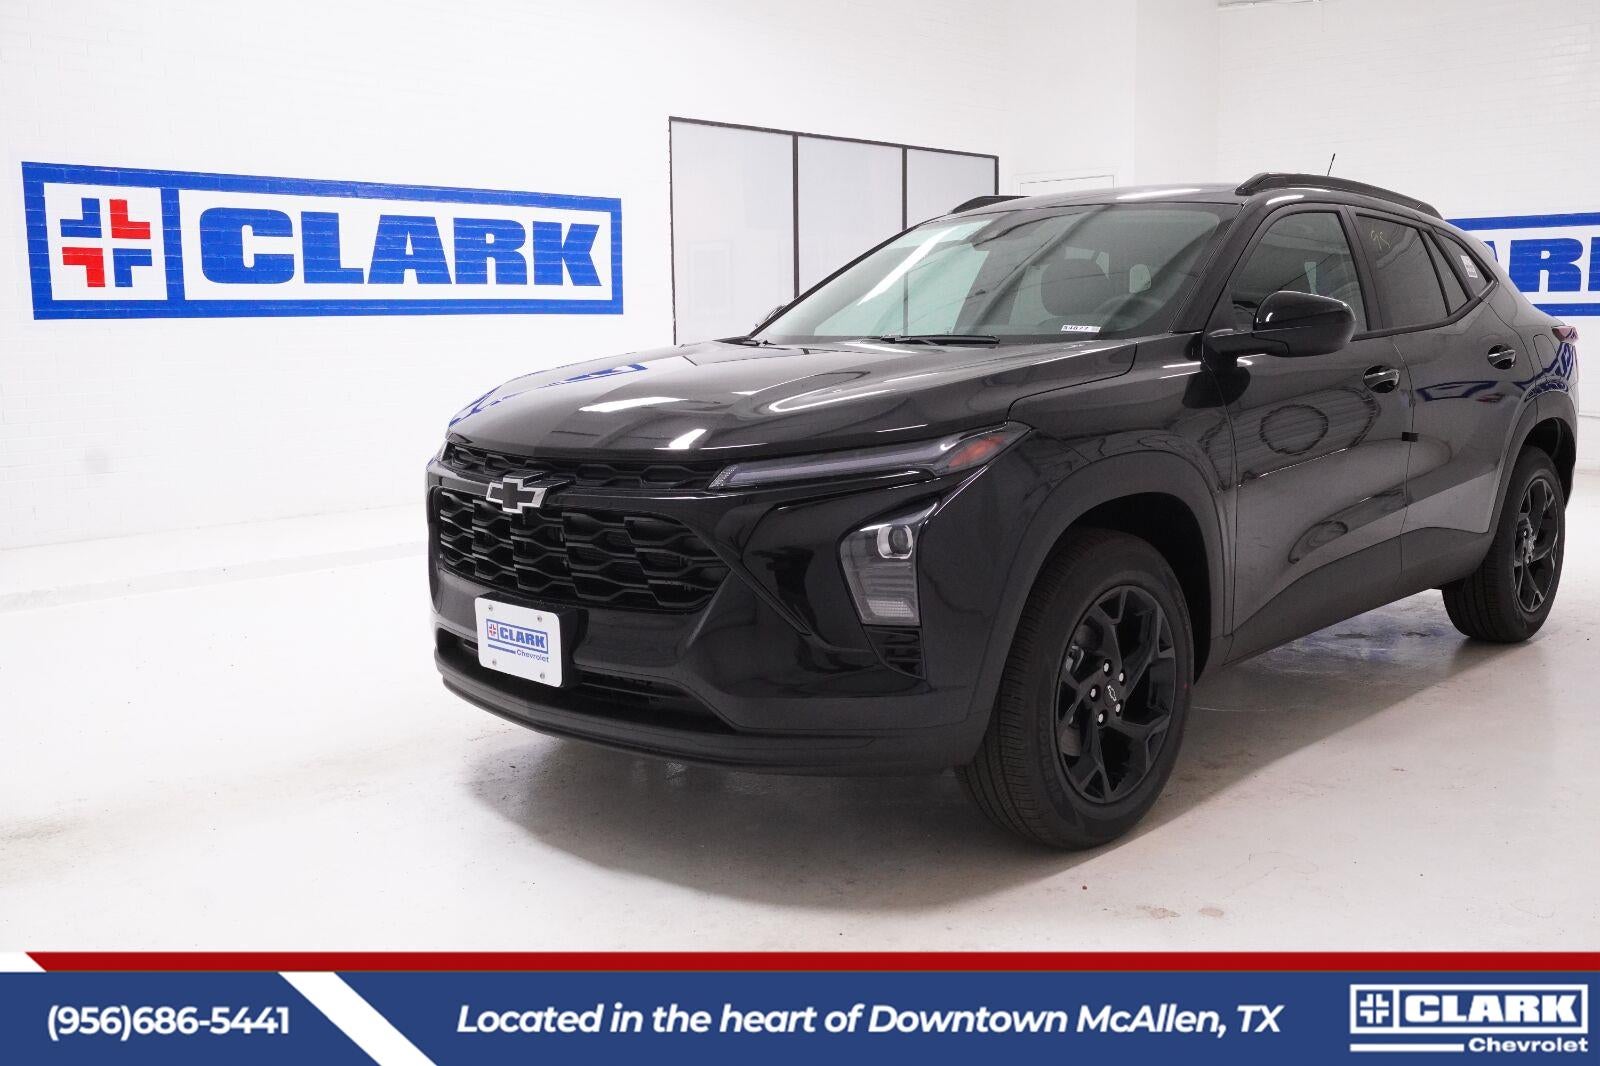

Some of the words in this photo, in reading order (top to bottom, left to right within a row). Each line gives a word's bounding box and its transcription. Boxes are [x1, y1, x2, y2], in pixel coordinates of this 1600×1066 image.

[199, 206, 603, 287] CLARK
[500, 626, 545, 648] CLARK
[516, 650, 549, 662] Chevrolet
